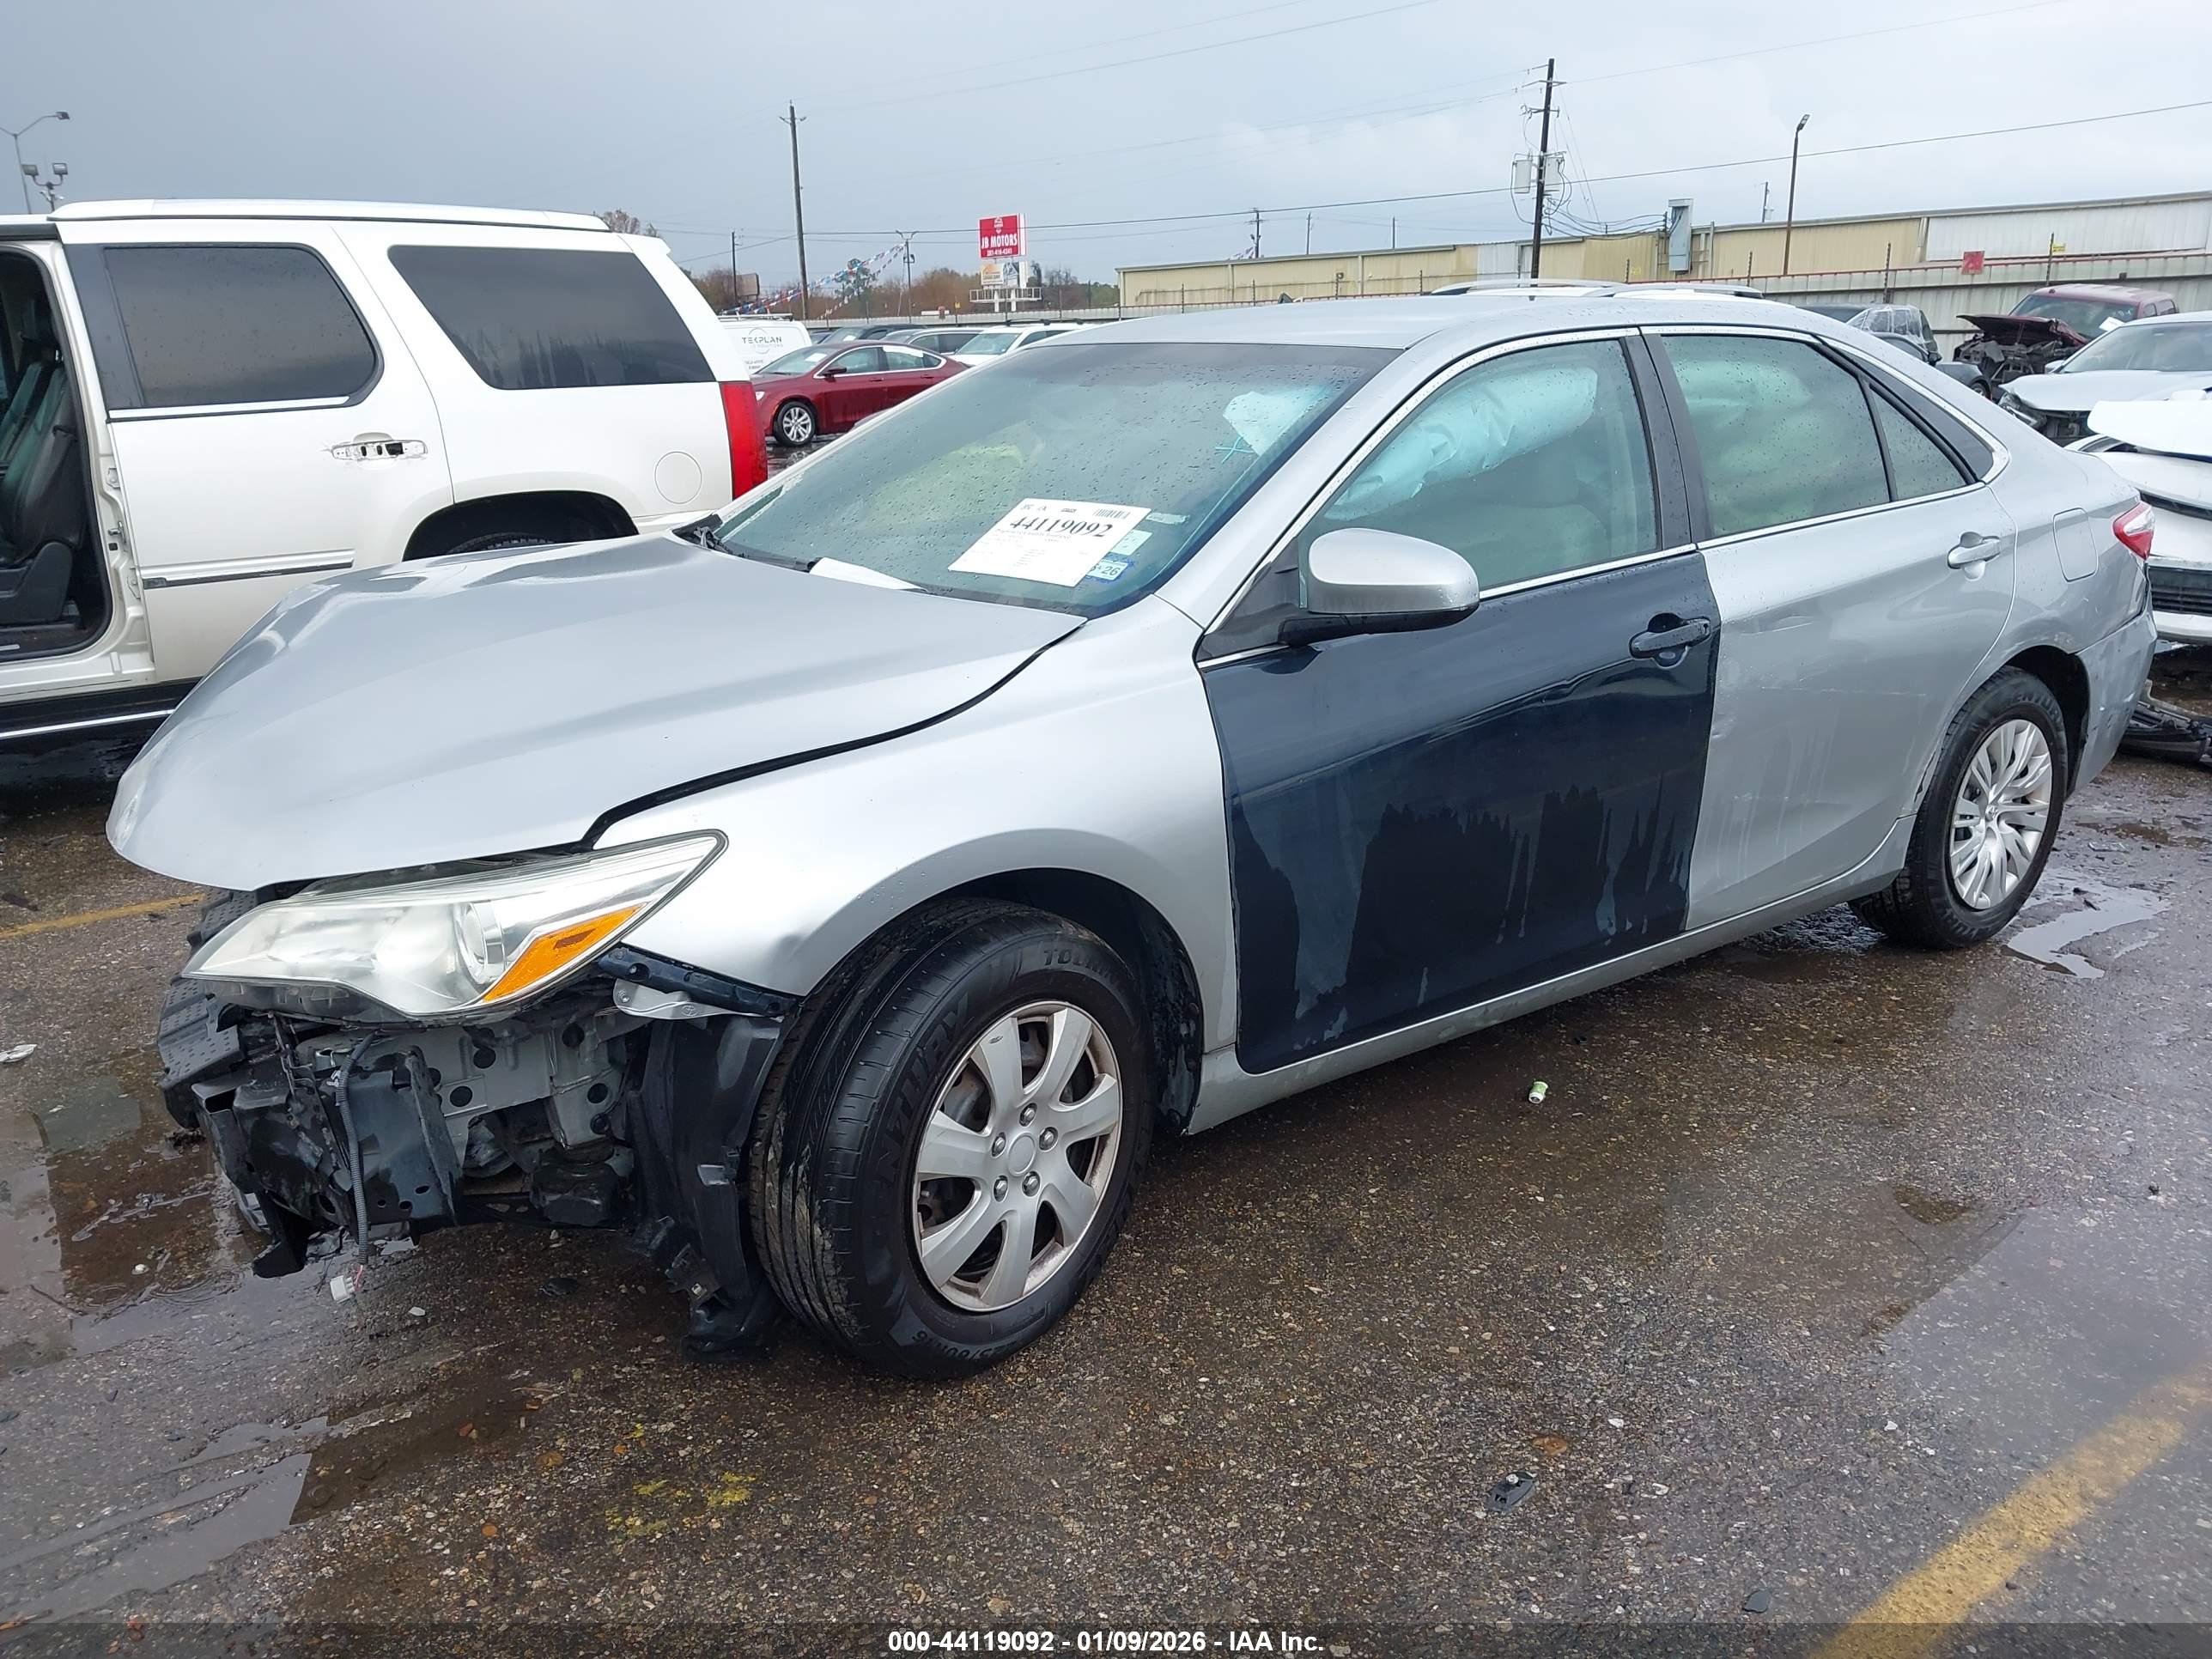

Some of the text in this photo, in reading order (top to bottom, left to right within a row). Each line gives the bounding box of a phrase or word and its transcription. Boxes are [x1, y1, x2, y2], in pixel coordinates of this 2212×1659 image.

[981, 234, 1018, 249] JB MOTORS
[741, 336, 782, 344] TEKPLAN
[1010, 516, 1114, 538] 44119092
